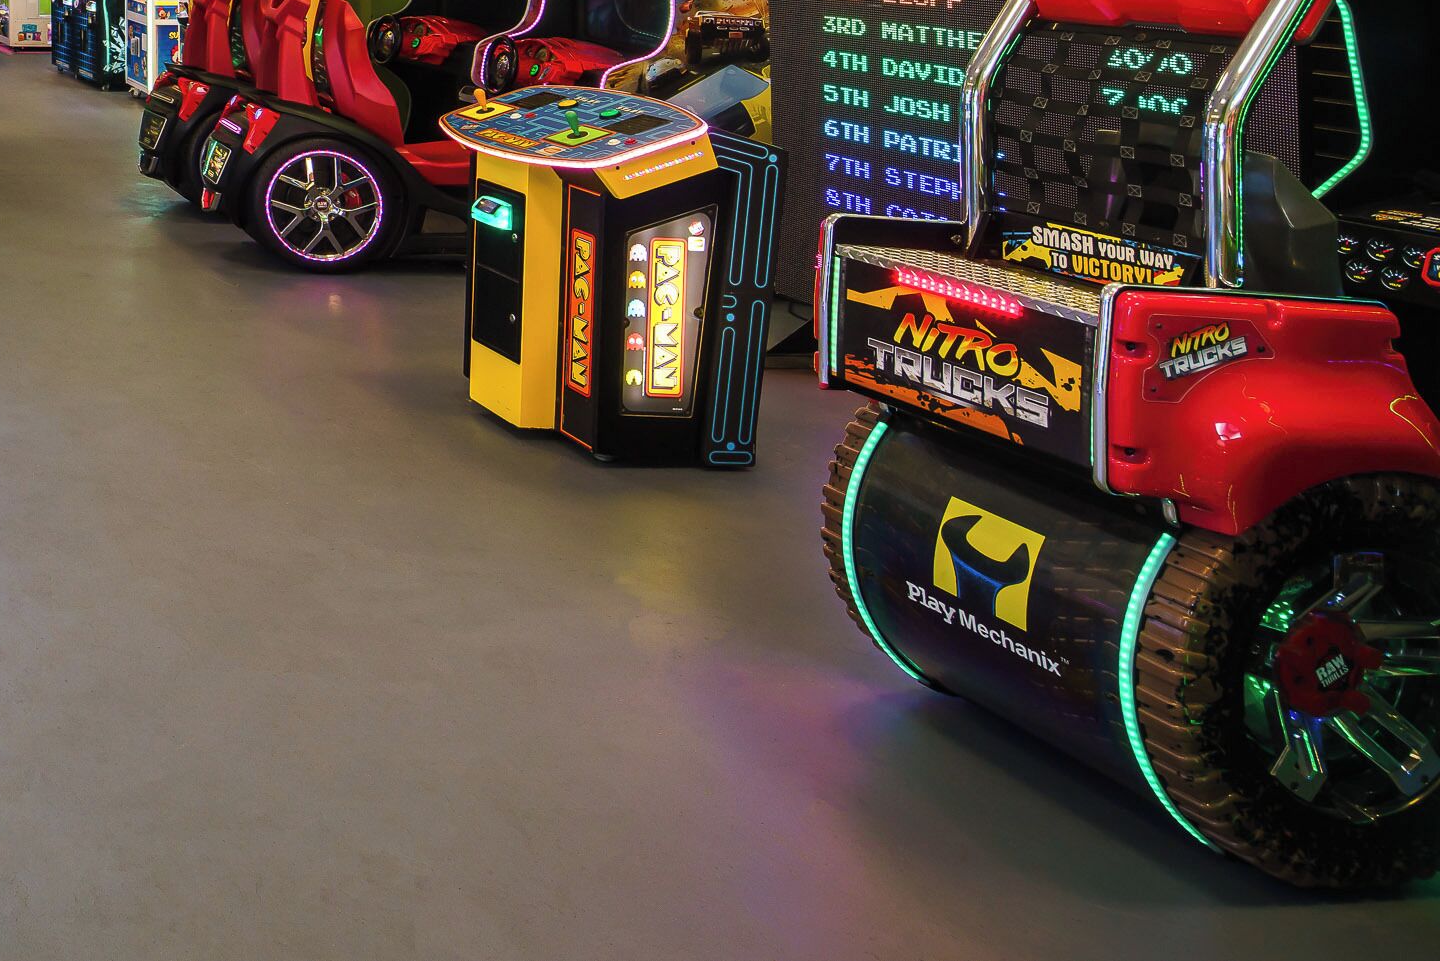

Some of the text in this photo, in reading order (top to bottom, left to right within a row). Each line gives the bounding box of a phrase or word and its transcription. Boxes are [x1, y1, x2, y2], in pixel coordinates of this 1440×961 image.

[822, 15, 989, 50] 3RD MATTHE
[823, 50, 965, 87] 4TH DAVID
[824, 84, 951, 122] 5TH JOSH
[479, 128, 535, 149] PAC-MAN
[824, 120, 961, 163] 6TH PATRI
[825, 153, 870, 180] 7TH
[1032, 226, 1173, 270] SMASH YOUR WAY
[1051, 251, 1152, 283] TO VICTORY!
[571, 237, 593, 387] PAC-MAN
[653, 245, 682, 390] PAC-MAN
[893, 312, 1019, 376] NITRO
[1159, 336, 1248, 378] TRUCKS
[1171, 322, 1230, 358] NITRO
[867, 337, 1050, 429] TRUCKS
[906, 580, 1062, 677] Play Mechanix
[1315, 653, 1346, 681] RAW
[1320, 665, 1349, 688] THRILLS
